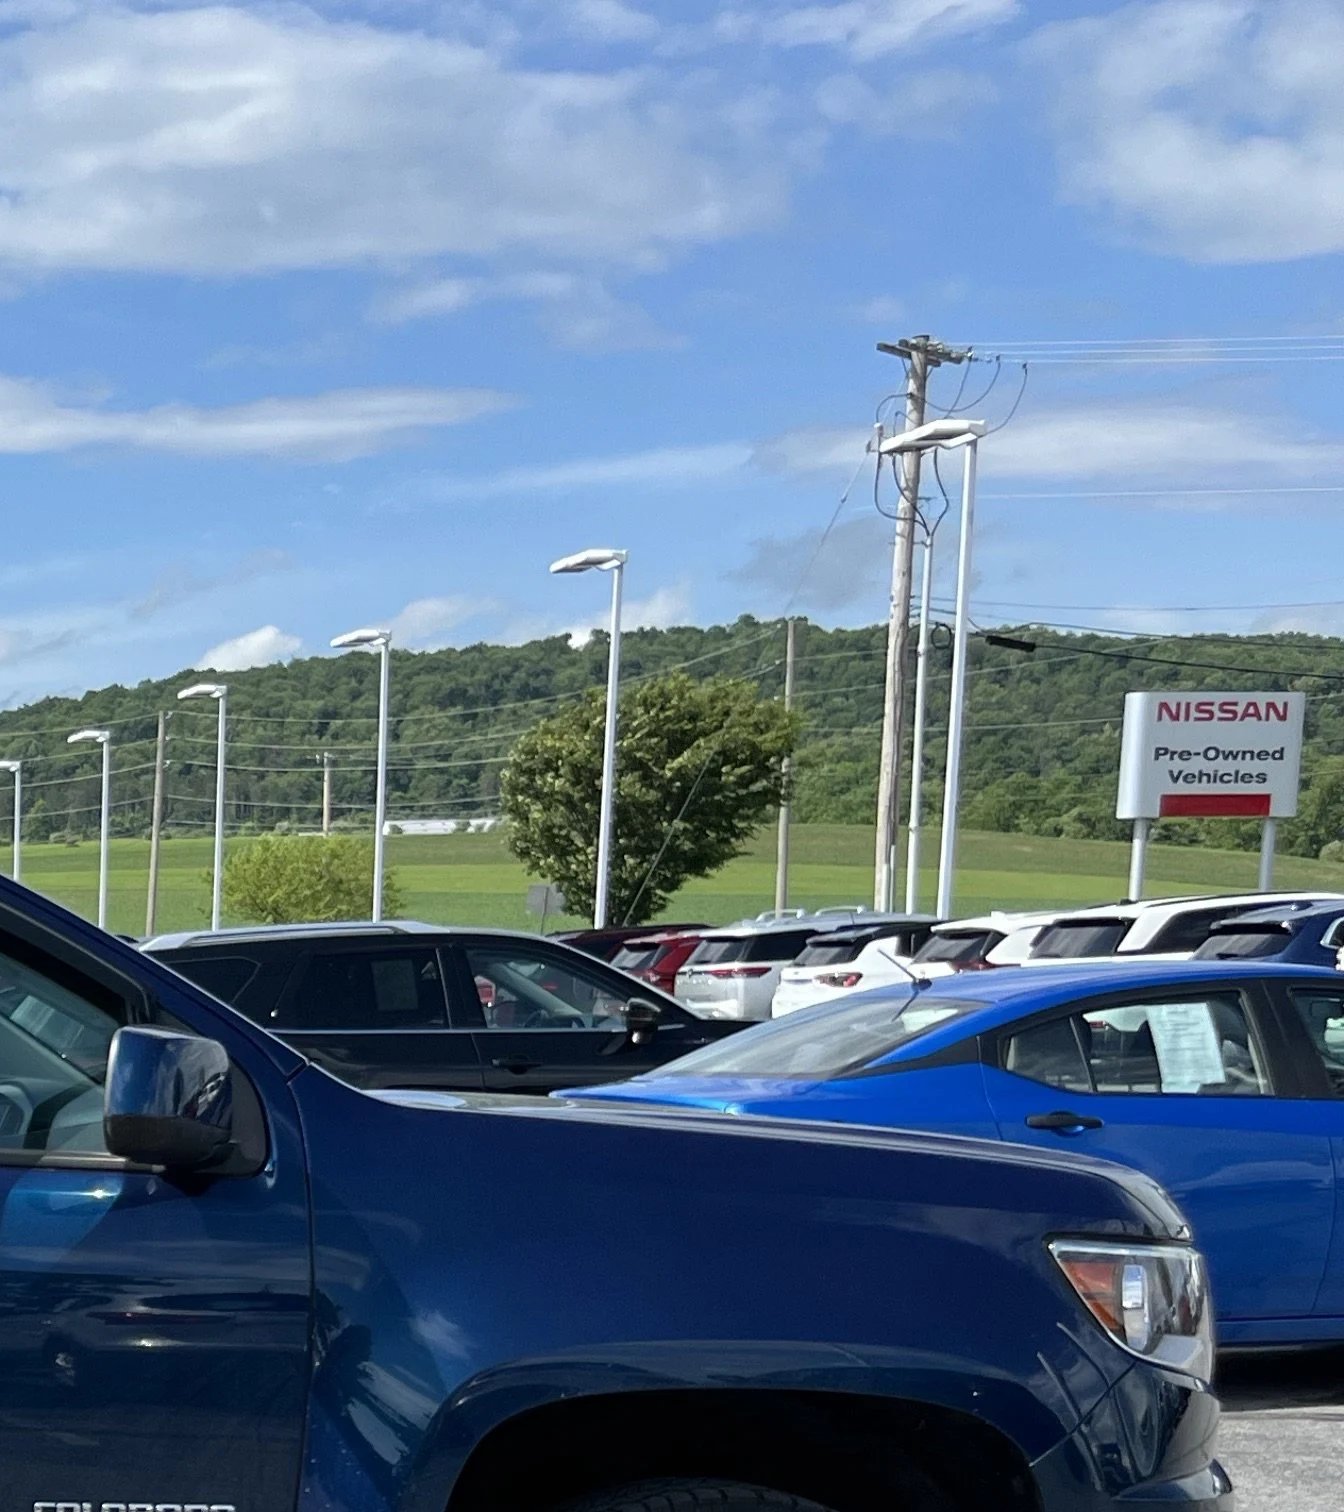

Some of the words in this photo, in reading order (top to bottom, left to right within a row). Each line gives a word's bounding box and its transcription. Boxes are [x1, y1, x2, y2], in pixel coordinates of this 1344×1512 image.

[1156, 701, 1288, 721] NISSAN
[1153, 746, 1285, 761] Pre-Owned
[1168, 769, 1268, 784] Vehicles
